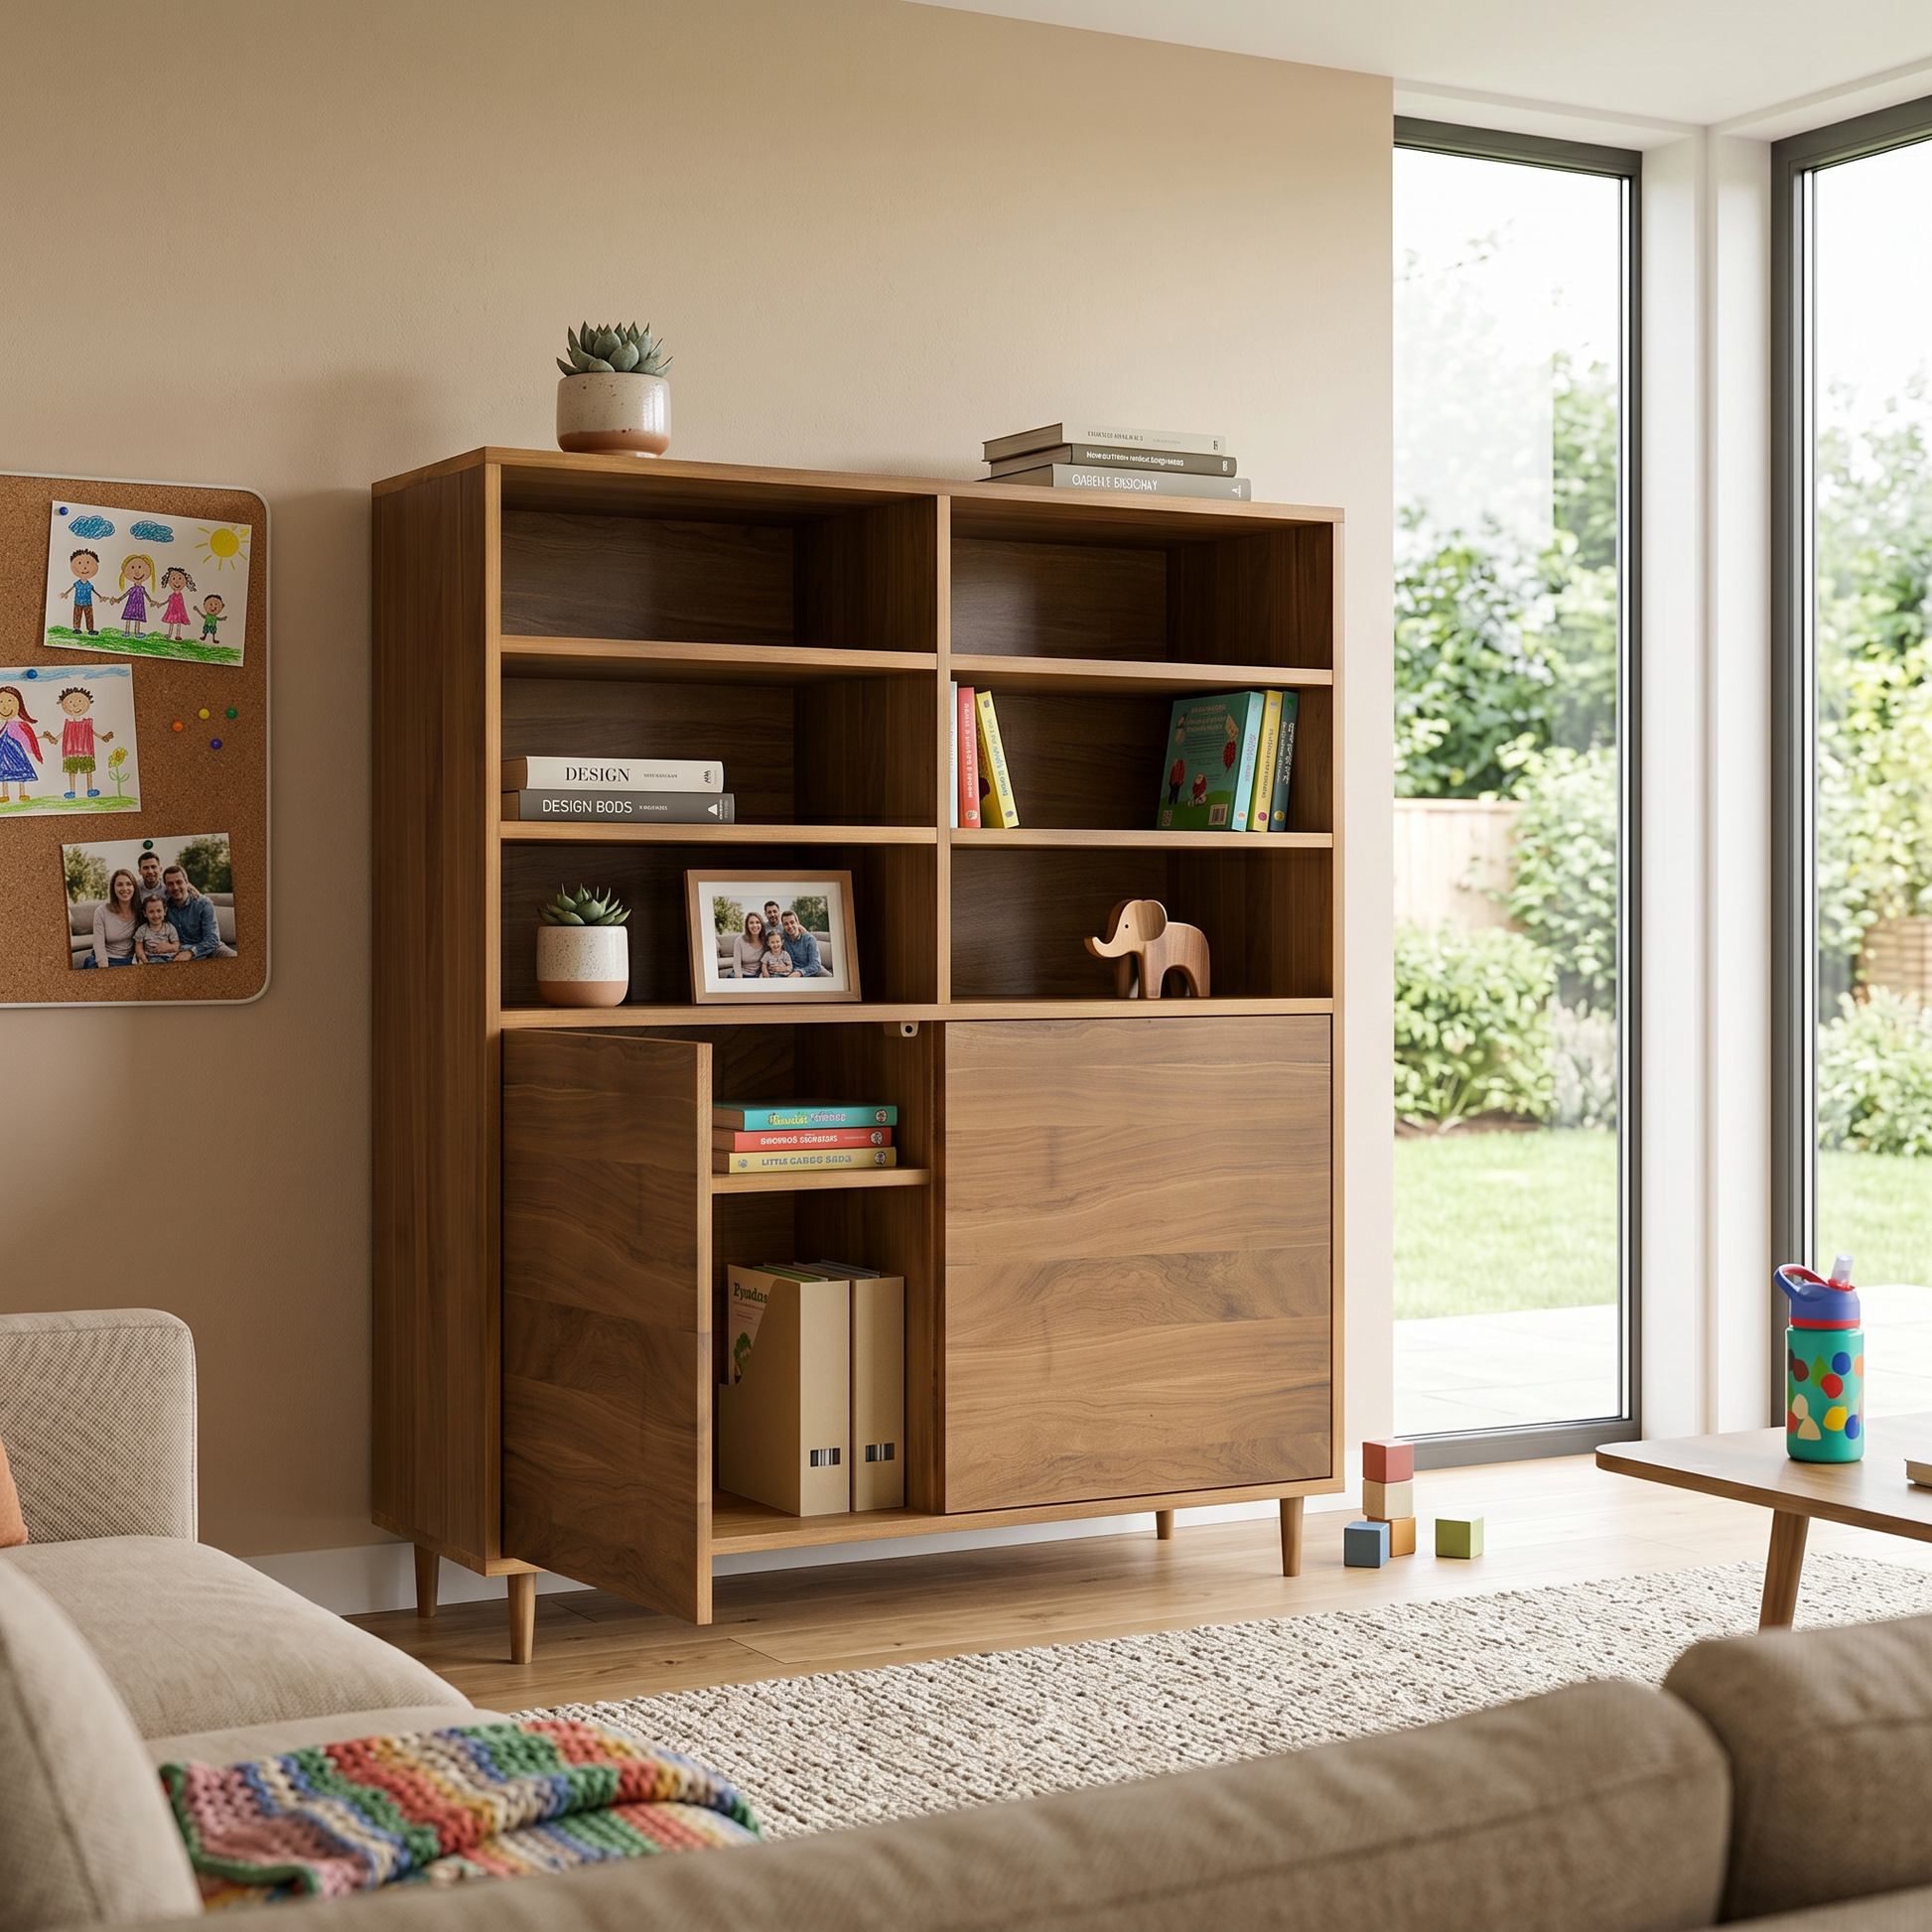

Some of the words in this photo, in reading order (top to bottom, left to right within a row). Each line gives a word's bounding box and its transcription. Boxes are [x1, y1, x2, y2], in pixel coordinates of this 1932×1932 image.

[565, 766, 630, 782] DESIGN
[542, 799, 592, 813] DESIGN
[596, 800, 632, 814] BODS
